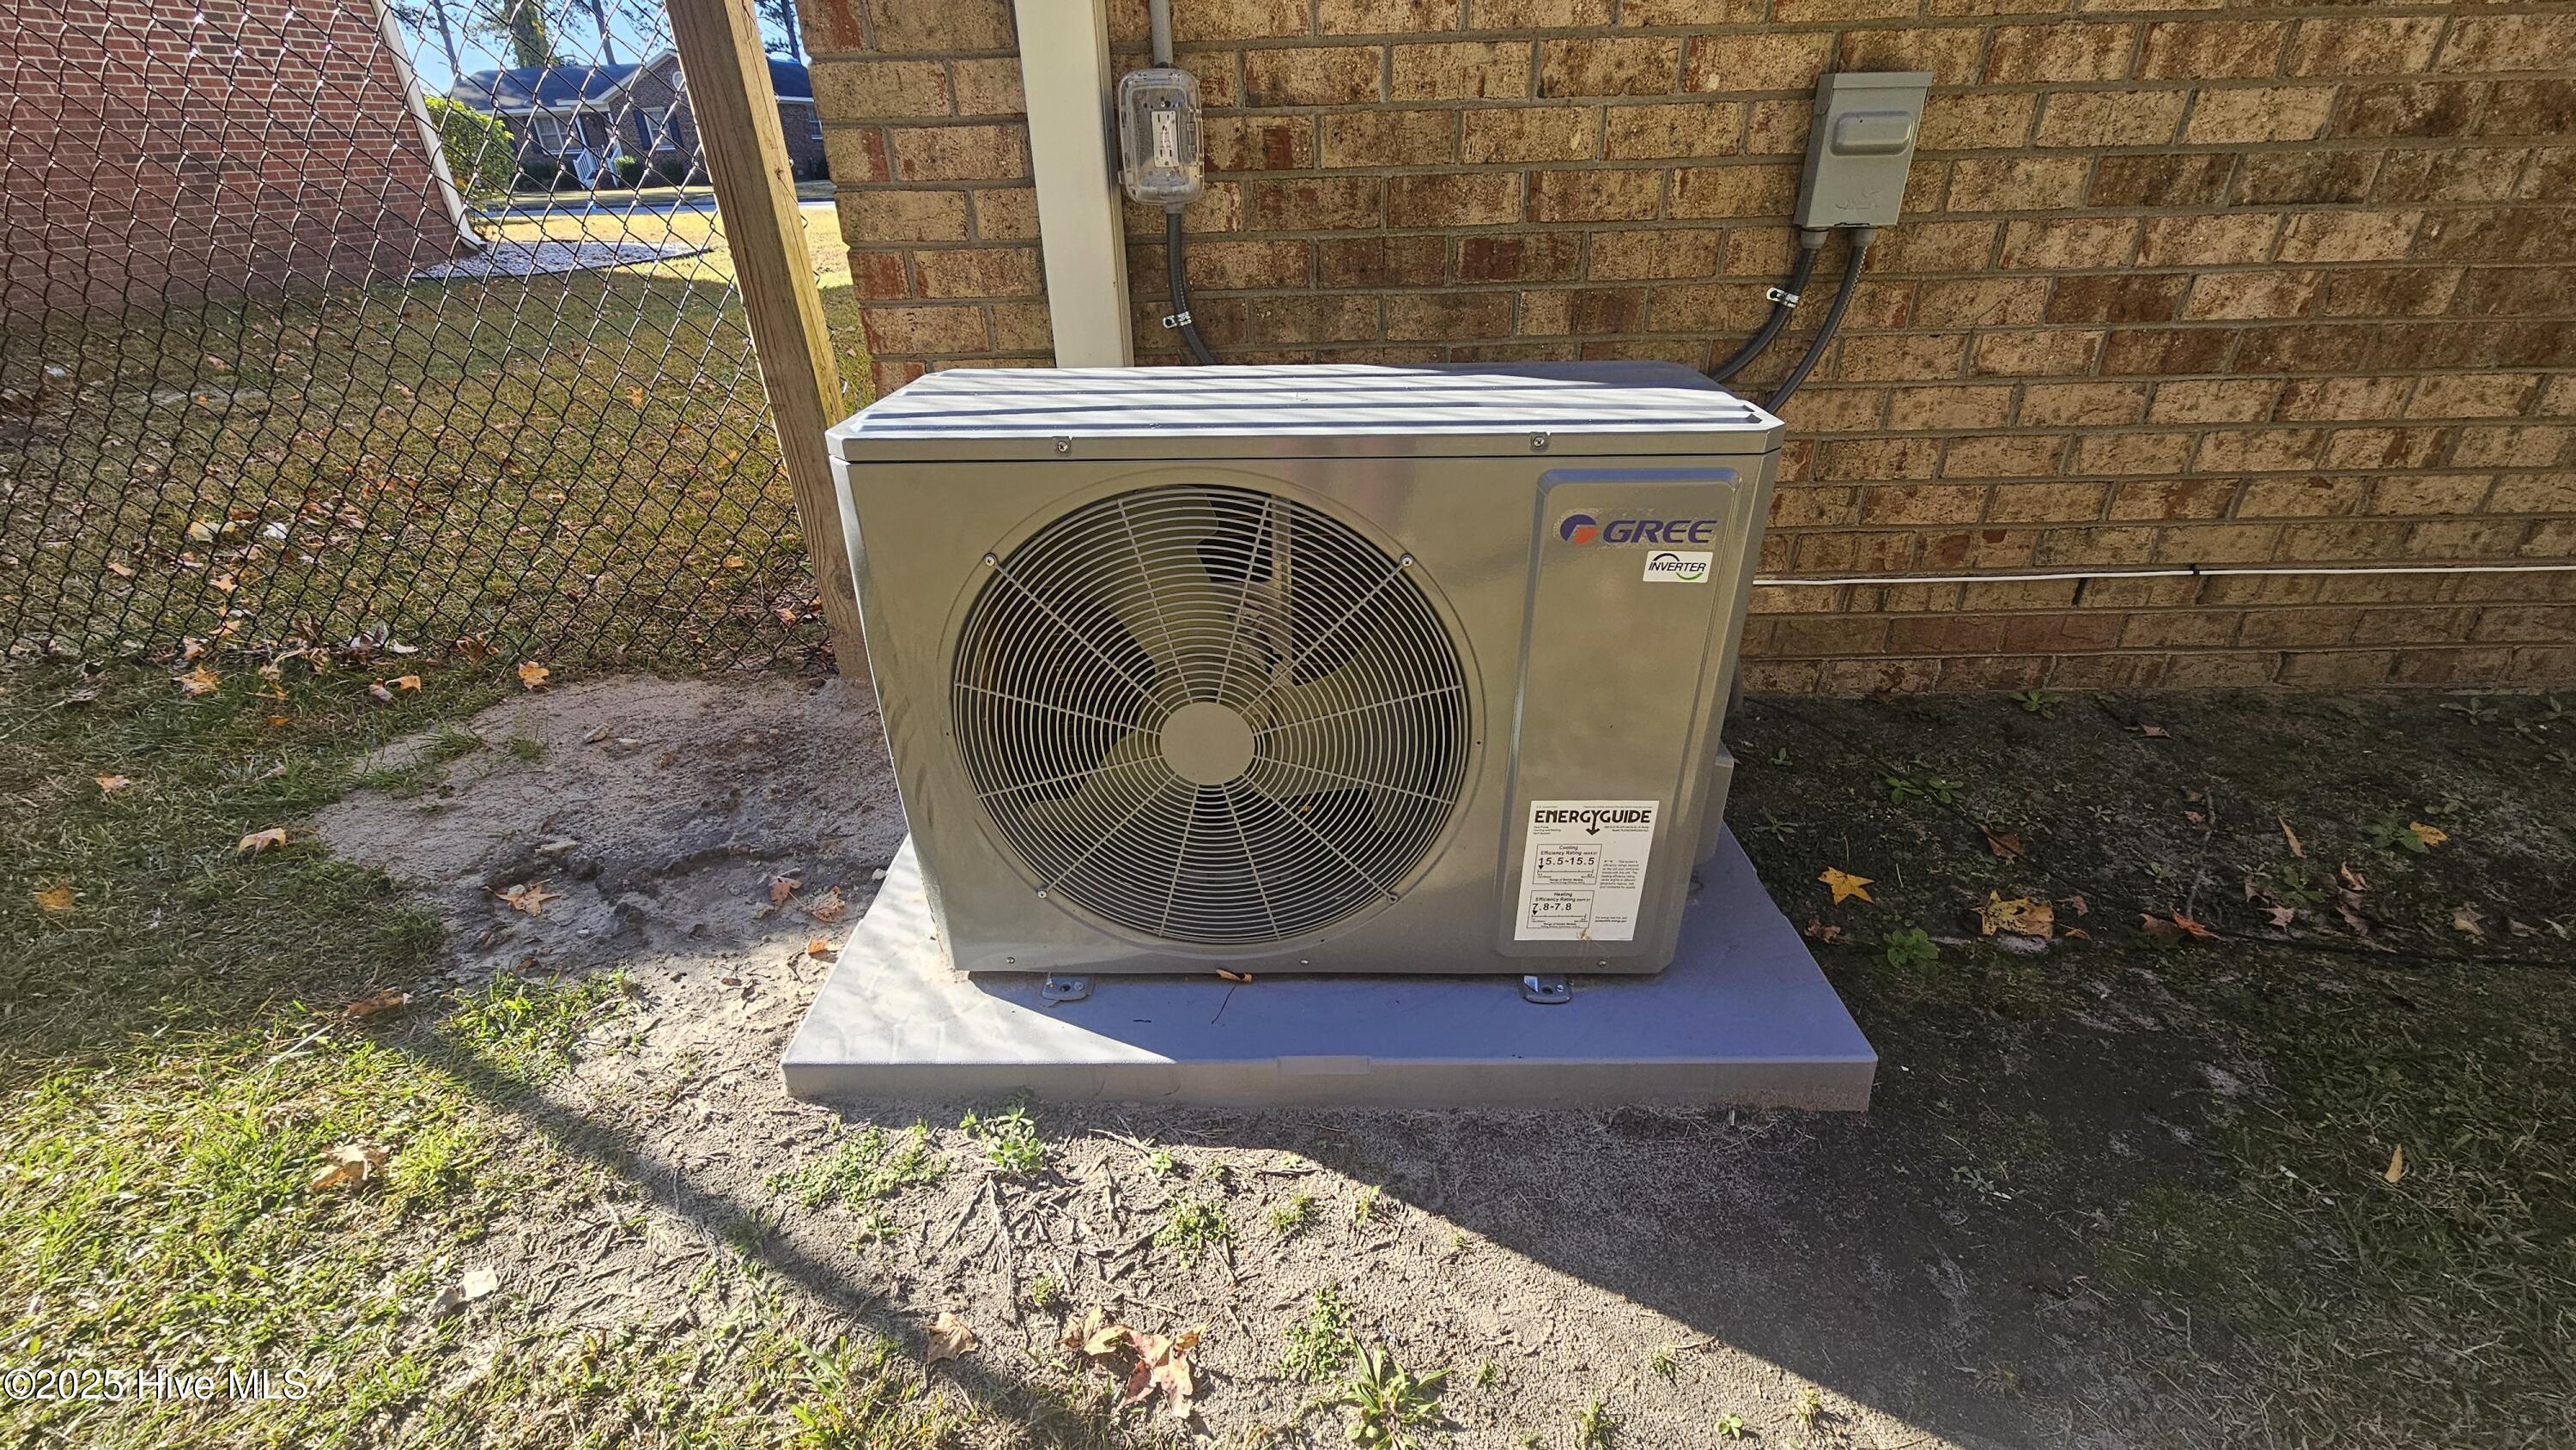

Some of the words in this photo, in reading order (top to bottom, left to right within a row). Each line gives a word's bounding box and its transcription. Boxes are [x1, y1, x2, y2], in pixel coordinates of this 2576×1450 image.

[1602, 519, 1718, 543] GREE
[1648, 561, 1707, 573] INVERTER
[1534, 810, 1652, 828] ENERGYGUIDE
[1538, 857, 1595, 865] 15.5-15.5
[1532, 902, 1572, 912] 7.8-7.8
